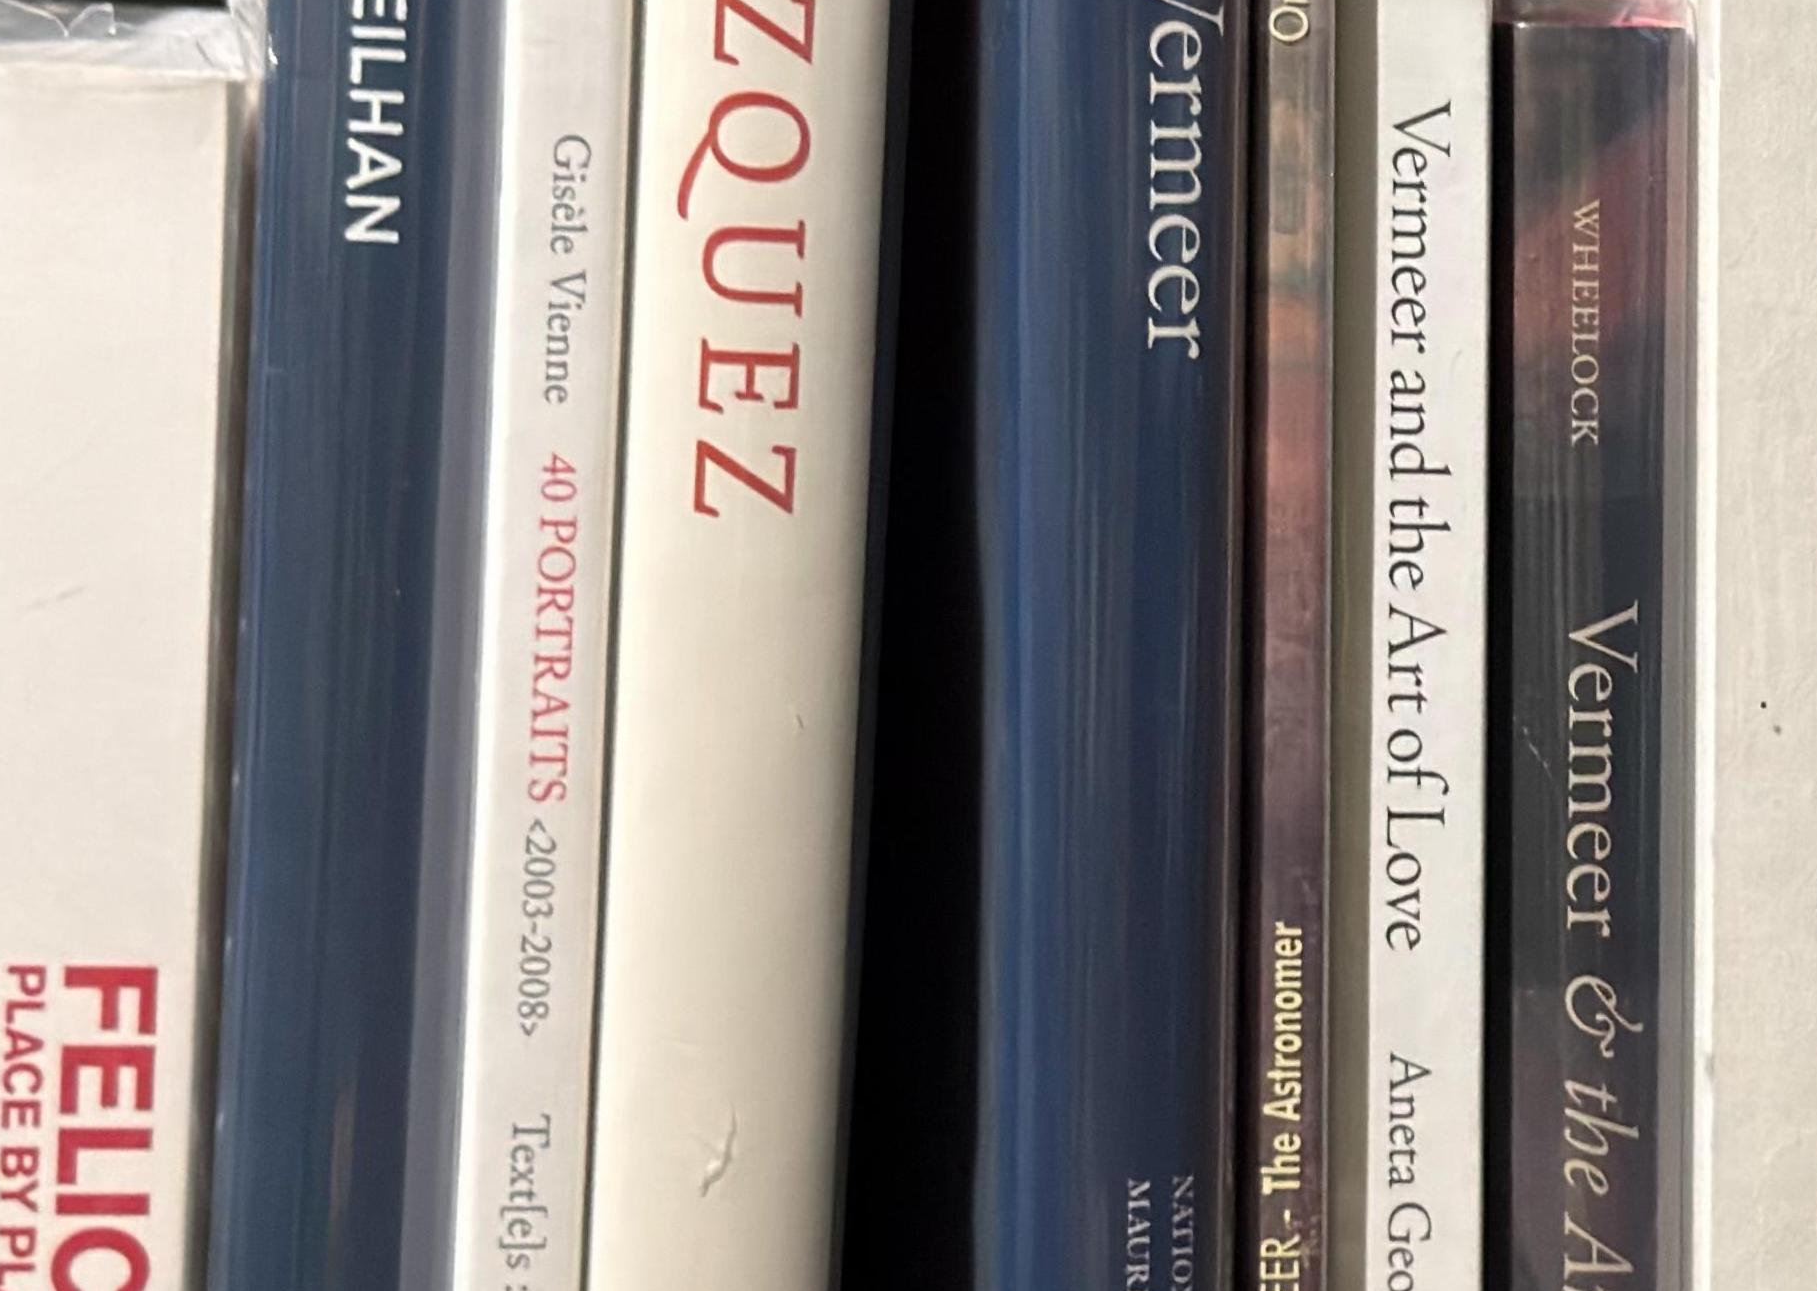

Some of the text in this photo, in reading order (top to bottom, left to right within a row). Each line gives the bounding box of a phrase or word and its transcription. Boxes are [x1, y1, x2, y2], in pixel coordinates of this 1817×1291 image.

[550, 134, 591, 254] Gisèle
[1388, 100, 1452, 349] Vermeer
[543, 271, 587, 405] Vienne
[1571, 198, 1602, 447] WHEELOCK
[539, 453, 578, 503] 40
[1388, 369, 1452, 482] and
[1388, 490, 1451, 588] the
[527, 517, 578, 805] PORTRAITS
[1387, 602, 1448, 715] Art
[1386, 727, 1450, 794] of
[1566, 600, 1640, 938] Vermeer
[1385, 807, 1446, 952] Love
[1, 965, 47, 1128] PLACE
[1262, 921, 1303, 1121] Astronomer
[1260, 1132, 1302, 1195] The
[1388, 1052, 1433, 1189] Aneta
[1564, 1077, 1640, 1197] the
[499, 1113, 552, 1270] Text[e]s
